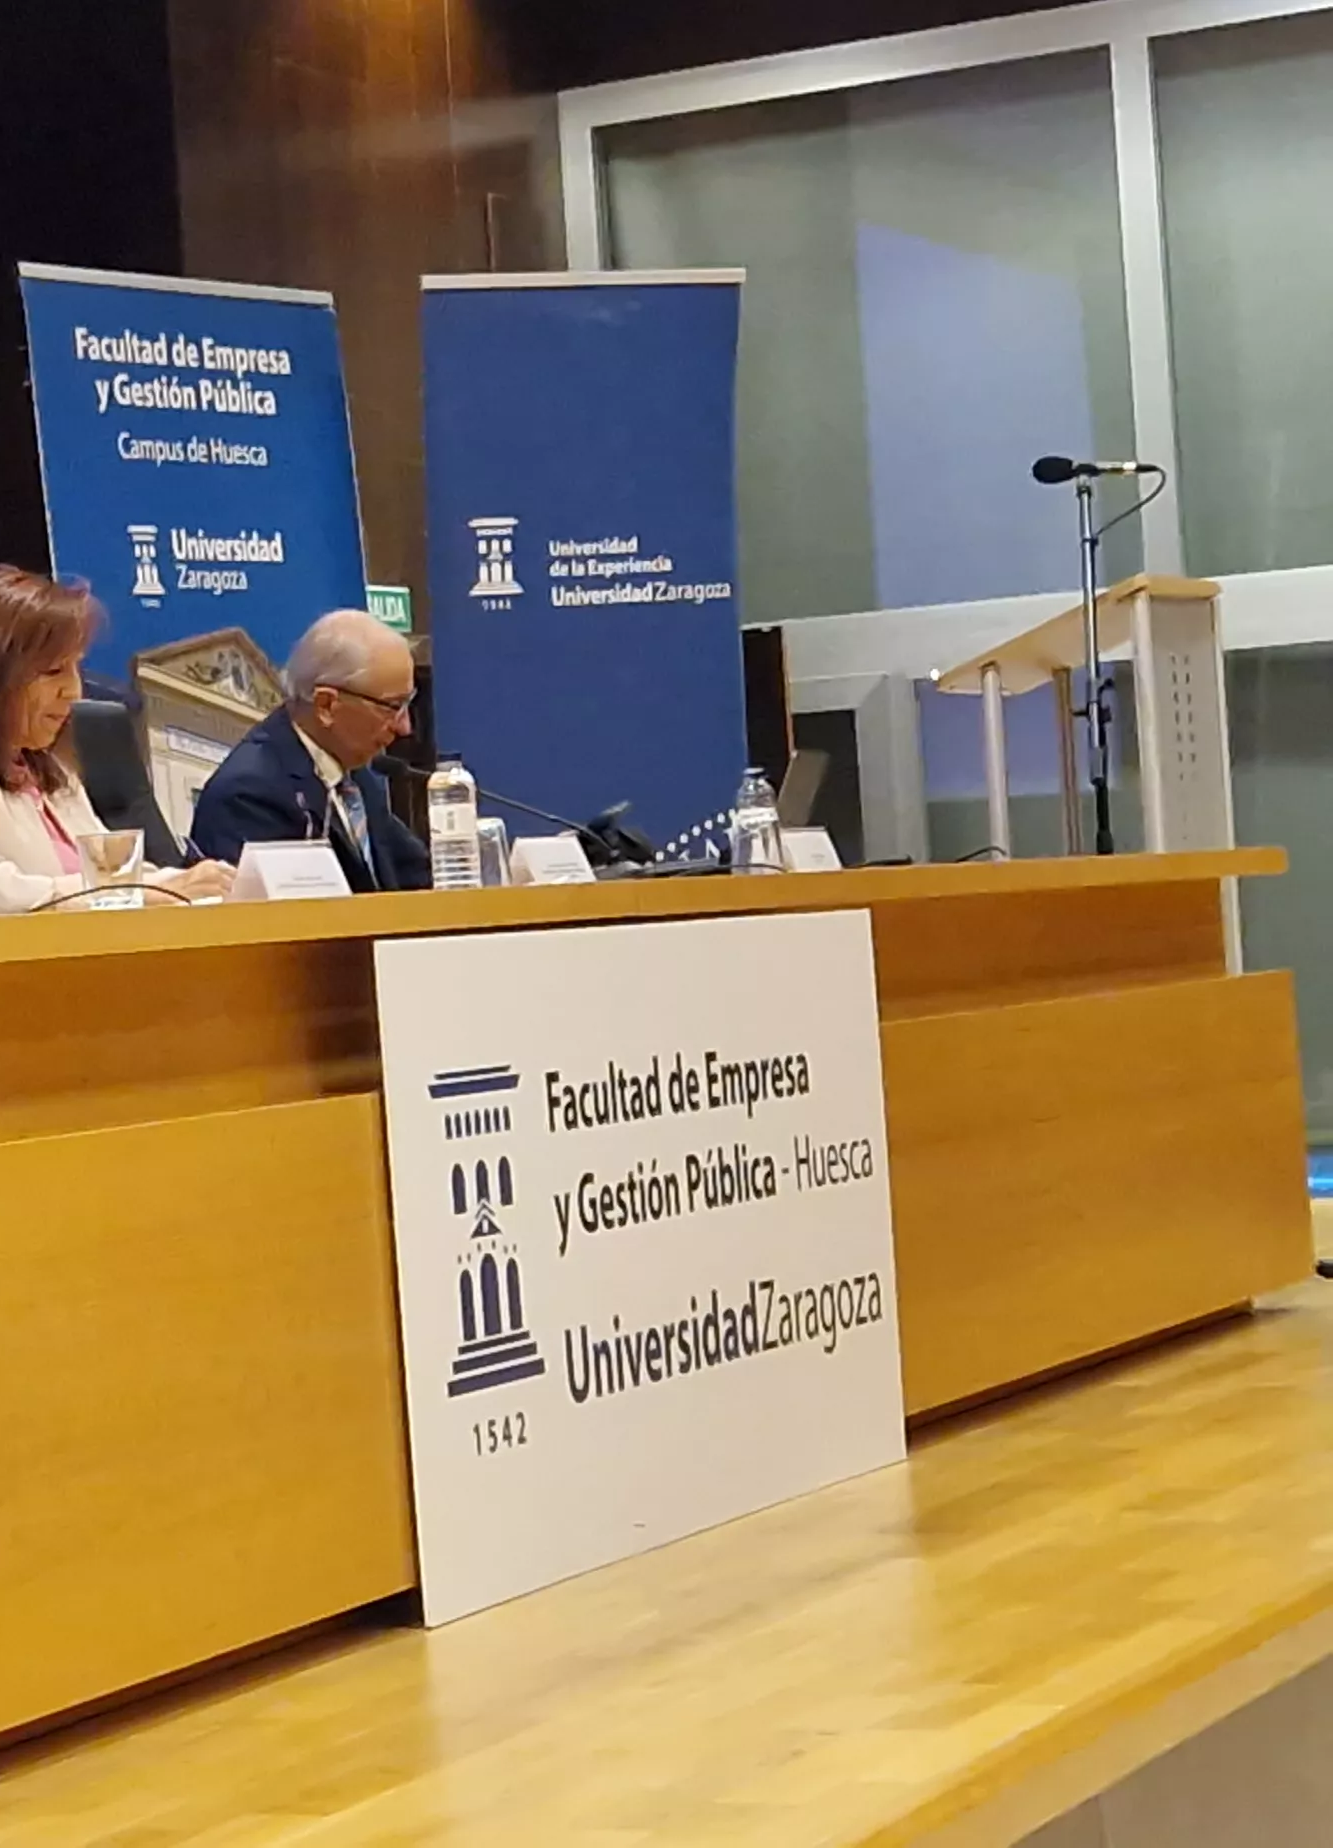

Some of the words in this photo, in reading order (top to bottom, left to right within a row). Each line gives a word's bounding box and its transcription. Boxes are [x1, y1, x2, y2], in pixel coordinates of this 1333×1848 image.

[74, 327, 168, 365] Facultad
[172, 334, 200, 367] de
[202, 337, 291, 379] Empresa
[95, 379, 109, 413] y
[113, 373, 197, 410] Gestión
[199, 379, 277, 415] Pública
[118, 431, 183, 467] Campus
[187, 435, 208, 462] de
[210, 438, 268, 466] Huesca
[171, 528, 284, 563] Universidad
[549, 536, 638, 557] Universidad
[175, 565, 248, 595] Zaragoza
[549, 561, 569, 577] de
[572, 561, 584, 576] la
[588, 556, 673, 578] Experiencia
[545, 1056, 662, 1133] Facultad
[668, 1052, 700, 1114] de
[705, 1051, 810, 1119] Empresa
[553, 1192, 570, 1258] y
[577, 1158, 681, 1234] Gestión
[685, 1143, 777, 1213] Pública
[794, 1134, 874, 1192] Huesca
[472, 1411, 528, 1456] 1542
